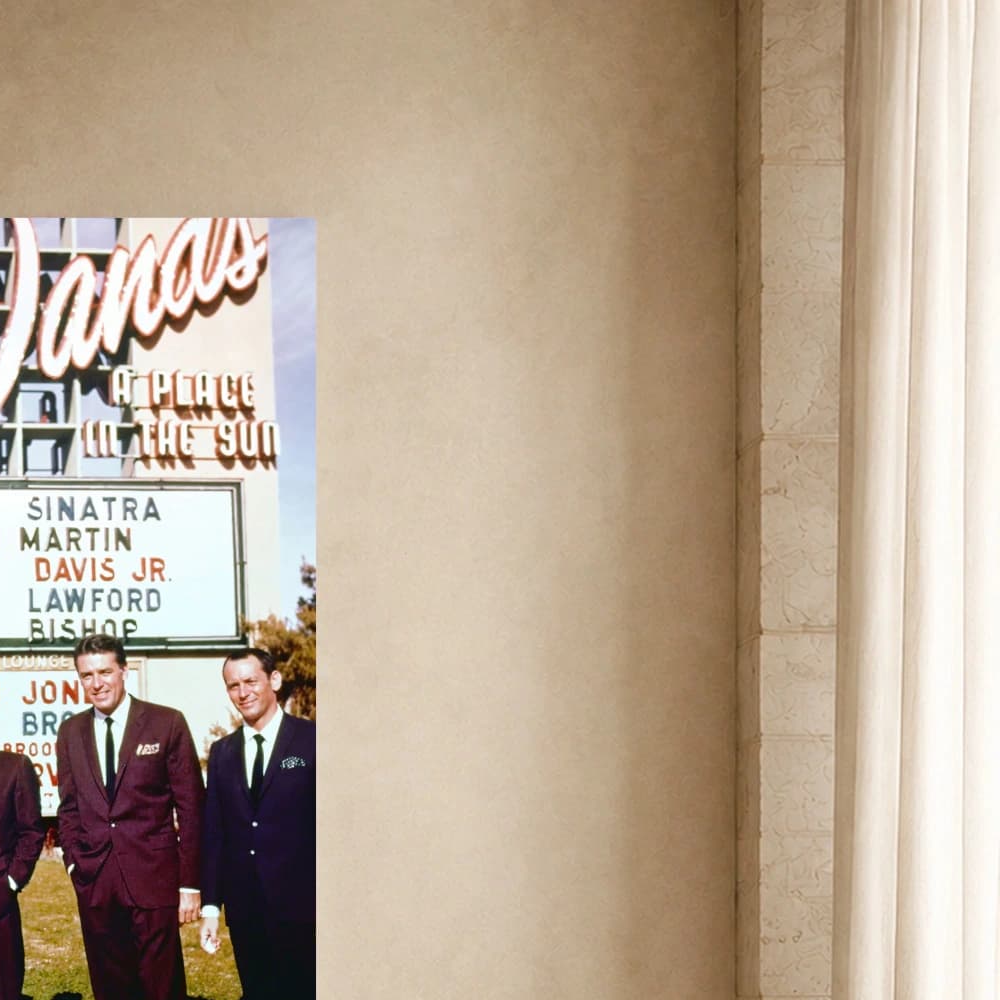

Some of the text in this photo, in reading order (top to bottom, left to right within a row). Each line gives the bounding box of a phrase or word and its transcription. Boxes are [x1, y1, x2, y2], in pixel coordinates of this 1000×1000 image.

[149, 370, 256, 408] PLACE
[83, 420, 118, 458] IN
[138, 420, 194, 458] THE
[215, 420, 281, 459] SUN
[26, 496, 162, 521] SINATRA
[19, 526, 132, 552] MARTIN
[34, 557, 116, 583] DAVIS
[131, 557, 173, 583] JR.
[28, 588, 162, 613] LAWFORD
[27, 618, 138, 645] BISHOP
[2, 655, 70, 668] LOUNGE
[22, 680, 93, 705] JON
